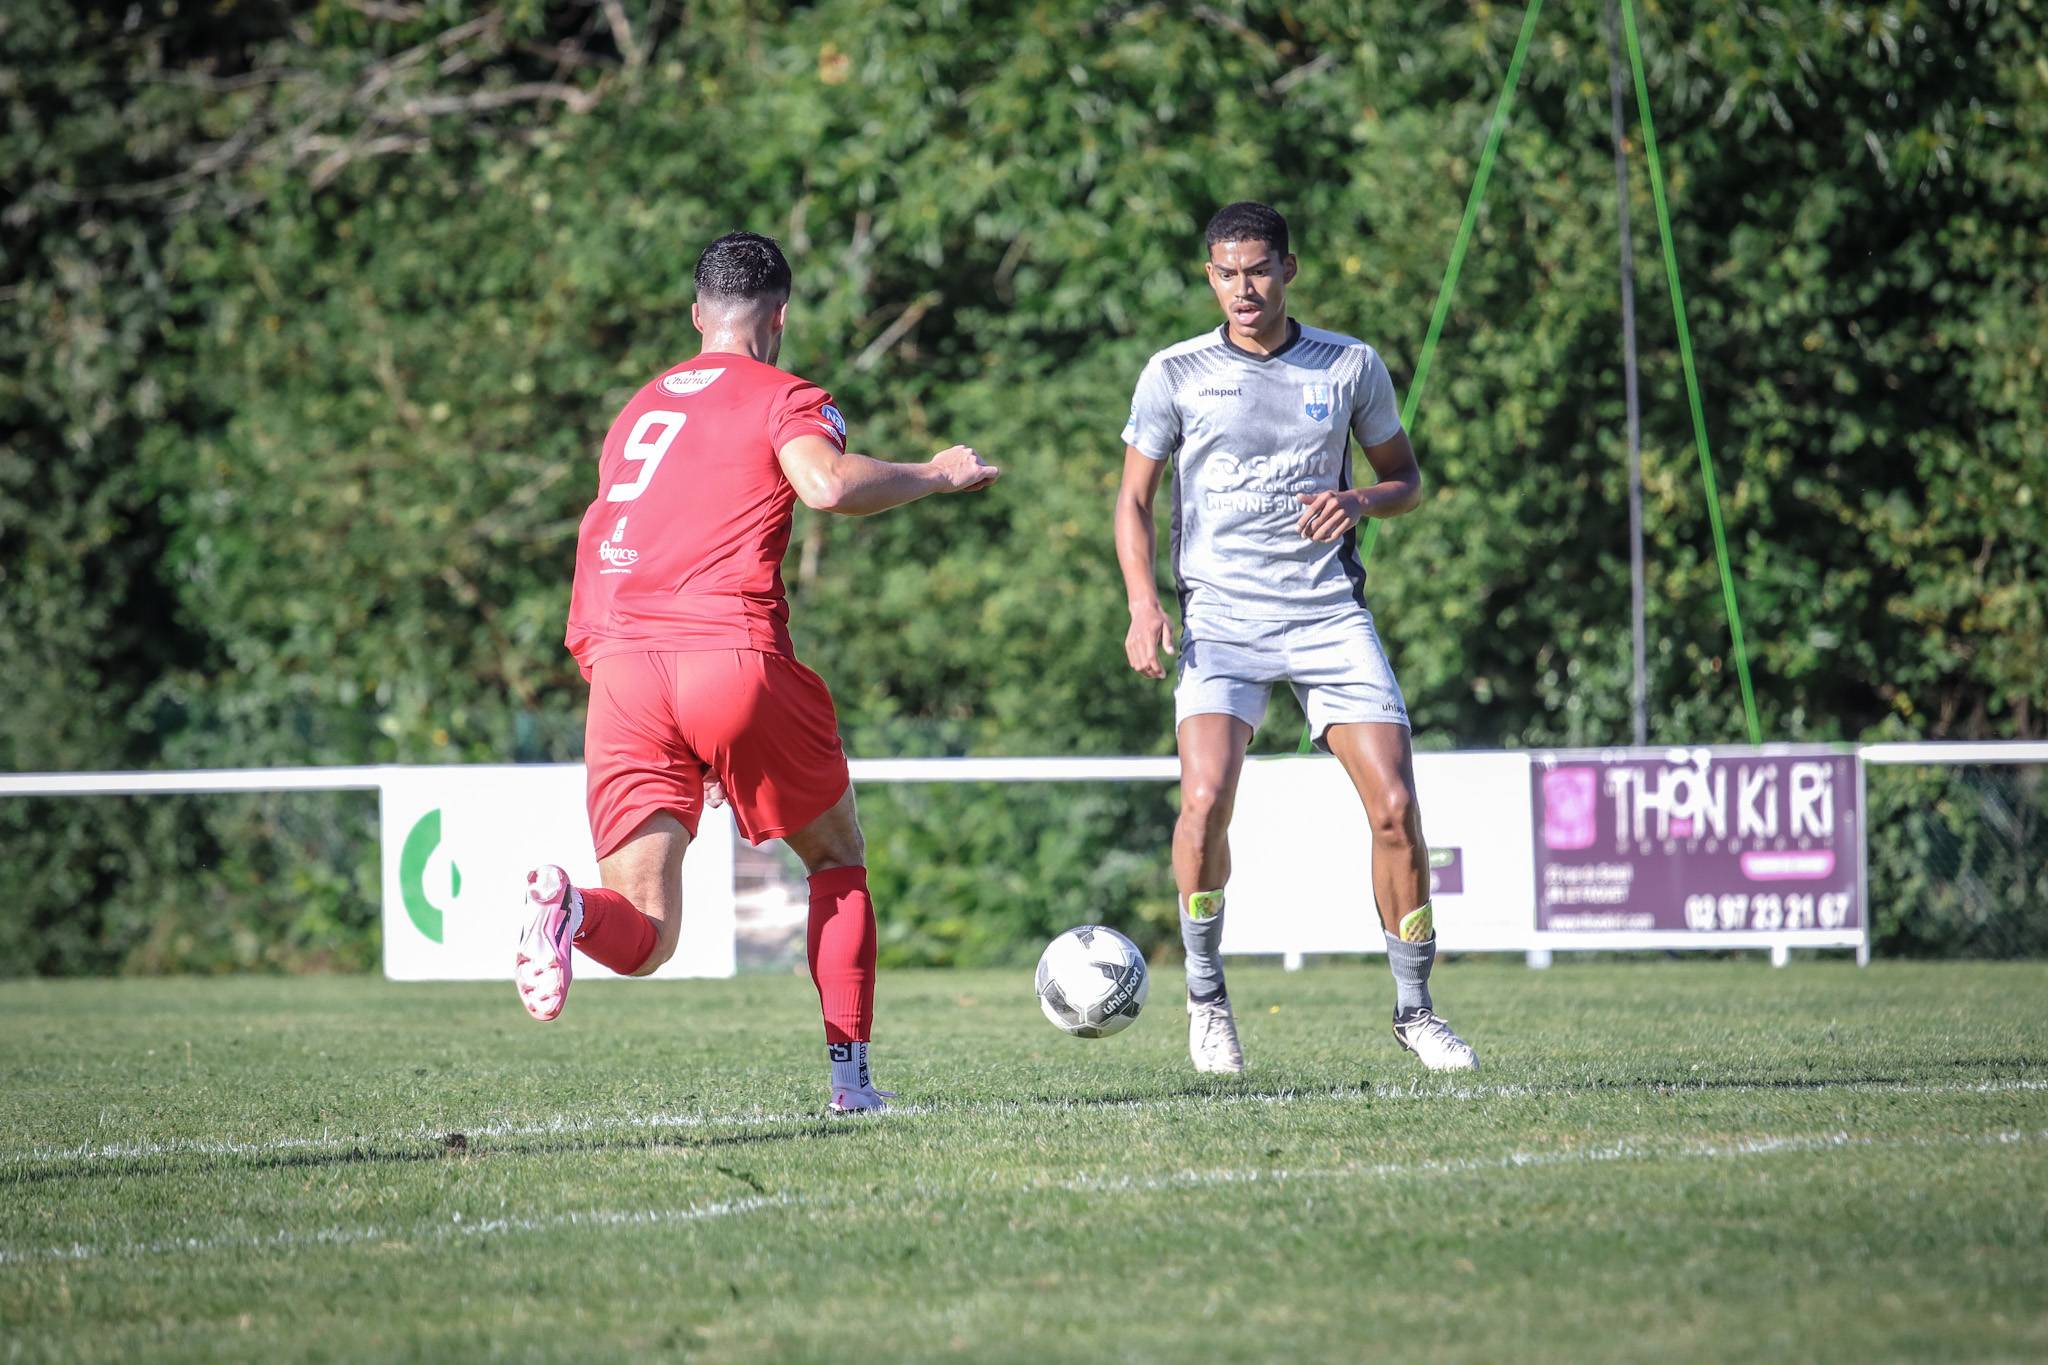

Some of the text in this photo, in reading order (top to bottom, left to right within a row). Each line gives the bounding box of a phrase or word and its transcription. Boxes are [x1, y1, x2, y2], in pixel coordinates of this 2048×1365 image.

[1198, 387, 1243, 398] uhlsport
[606, 410, 687, 502] 9
[1103, 967, 1141, 1015] uhlsport
